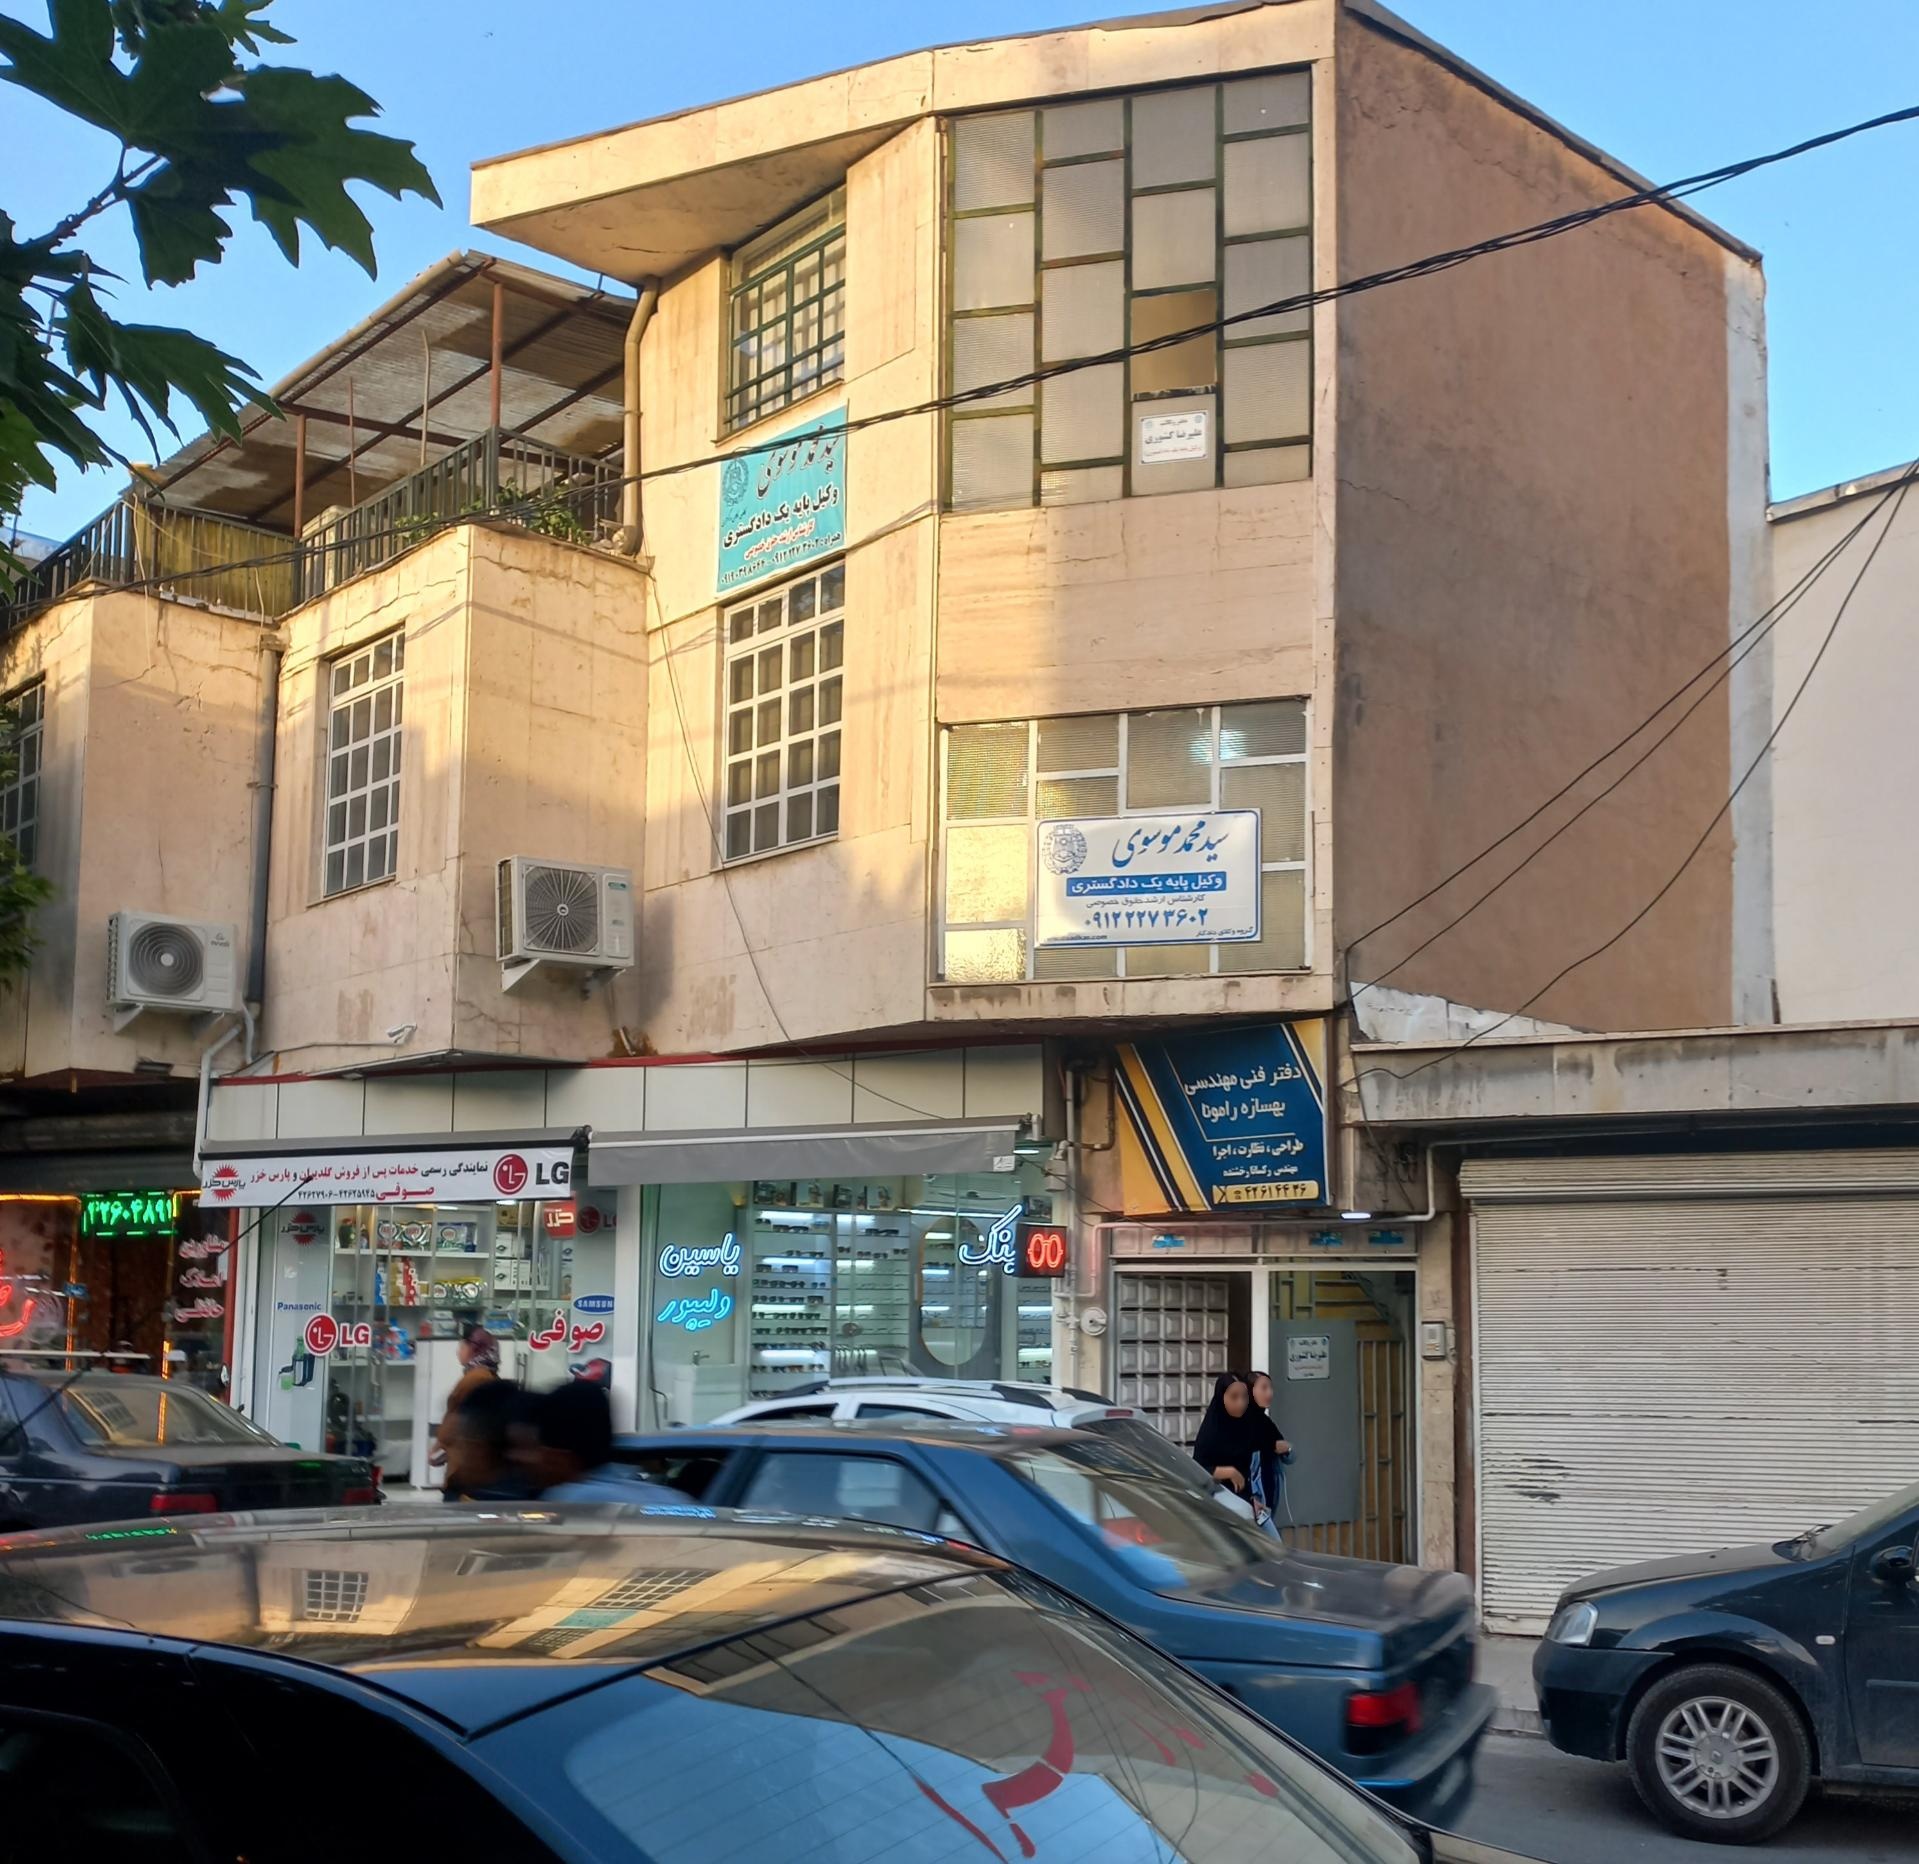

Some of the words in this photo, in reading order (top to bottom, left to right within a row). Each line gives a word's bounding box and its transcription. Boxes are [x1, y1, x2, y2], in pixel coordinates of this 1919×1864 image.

[812, 483, 839, 512] وکیل
[773, 503, 791, 523] یک
[723, 510, 772, 549] دادگستری
[1112, 824, 1182, 868] موسوی
[1173, 820, 1206, 855] محمد
[1196, 832, 1229, 863] سید
[1071, 878, 1139, 895] دادگستری
[1141, 877, 1164, 893] یک
[1166, 875, 1189, 892] پایه
[1192, 874, 1223, 891] وکیل
[1168, 894, 1206, 906] کارشناس
[1240, 1066, 1266, 1090] فنی
[1269, 1063, 1302, 1086] دفتر
[1185, 1073, 1238, 1095] مهندسی
[1201, 1101, 1238, 1122] رامونا
[1240, 1098, 1286, 1118] بهسازه
[1212, 1144, 1231, 1160] اجرا
[250, 1168, 267, 1184] خزر
[268, 1167, 291, 1183] پارس
[334, 1164, 361, 1181] فروش
[362, 1165, 371, 1180] از
[372, 1167, 388, 1180] پس
[390, 1164, 419, 1176] خدمات
[420, 1163, 447, 1178] رسمی
[448, 1160, 489, 1177] نمایندگی
[536, 1162, 570, 1185] LG
[1273, 1165, 1299, 1177] مهندس
[376, 1182, 435, 1201] صوفی
[660, 1233, 741, 1276] یاسین
[277, 1301, 322, 1312] Panasonic
[577, 1299, 613, 1309] SAMSUN
[341, 1324, 371, 1346] LG
[529, 1309, 604, 1351] صوفی
